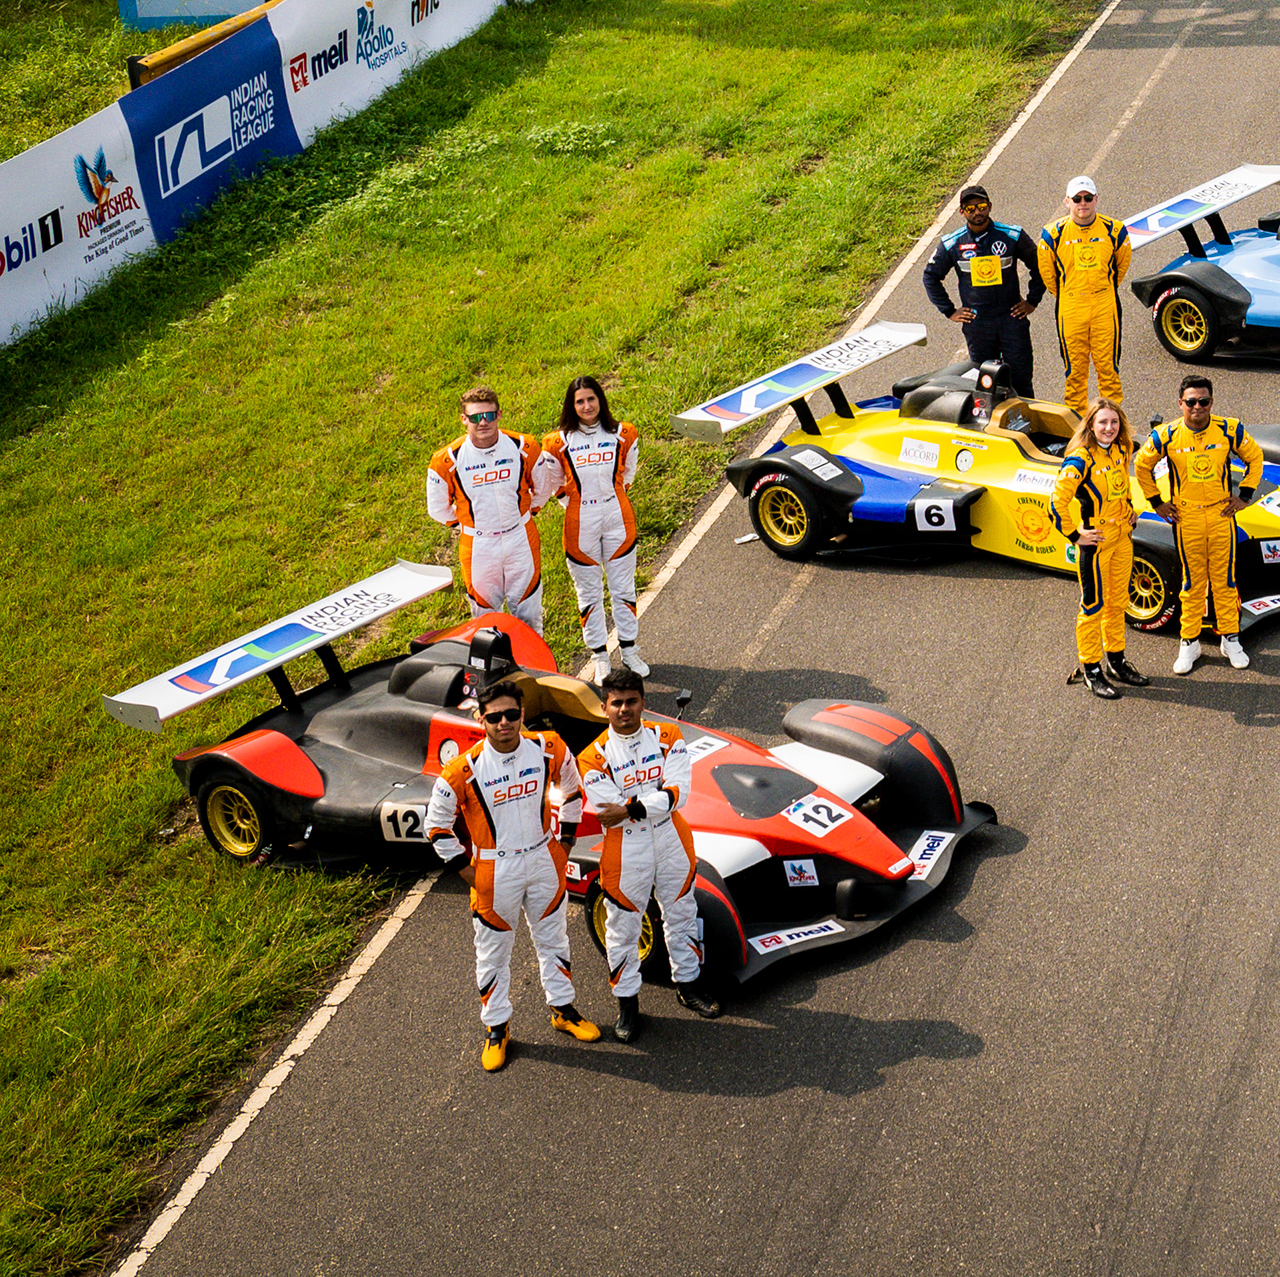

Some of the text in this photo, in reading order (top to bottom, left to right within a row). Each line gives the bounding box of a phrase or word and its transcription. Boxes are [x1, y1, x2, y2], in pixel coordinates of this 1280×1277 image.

[311, 29, 349, 81] meil
[355, 24, 395, 69] Apollo
[370, 41, 408, 71] HOSPITALS
[230, 71, 268, 110] INDIAN
[233, 89, 274, 129] RACING
[235, 110, 275, 152] LEAGUE
[76, 186, 140, 239] KINGFISHER
[811, 336, 871, 367] INDIAN
[902, 448, 938, 462] ACCORD
[472, 468, 510, 484] SDD
[1016, 473, 1043, 485] Mobil
[924, 505, 945, 527] 6
[1017, 497, 1044, 509] CHENNAI
[301, 589, 372, 625] INDIAN
[314, 592, 393, 629] RACING
[325, 595, 402, 632] LEAGUE
[485, 776, 503, 788] Mobil
[614, 761, 630, 773] Mobil
[493, 780, 538, 804] SDD
[386, 809, 423, 839] 12
[803, 804, 845, 829] 12
[917, 835, 946, 861] meil
[785, 924, 835, 941] meil
